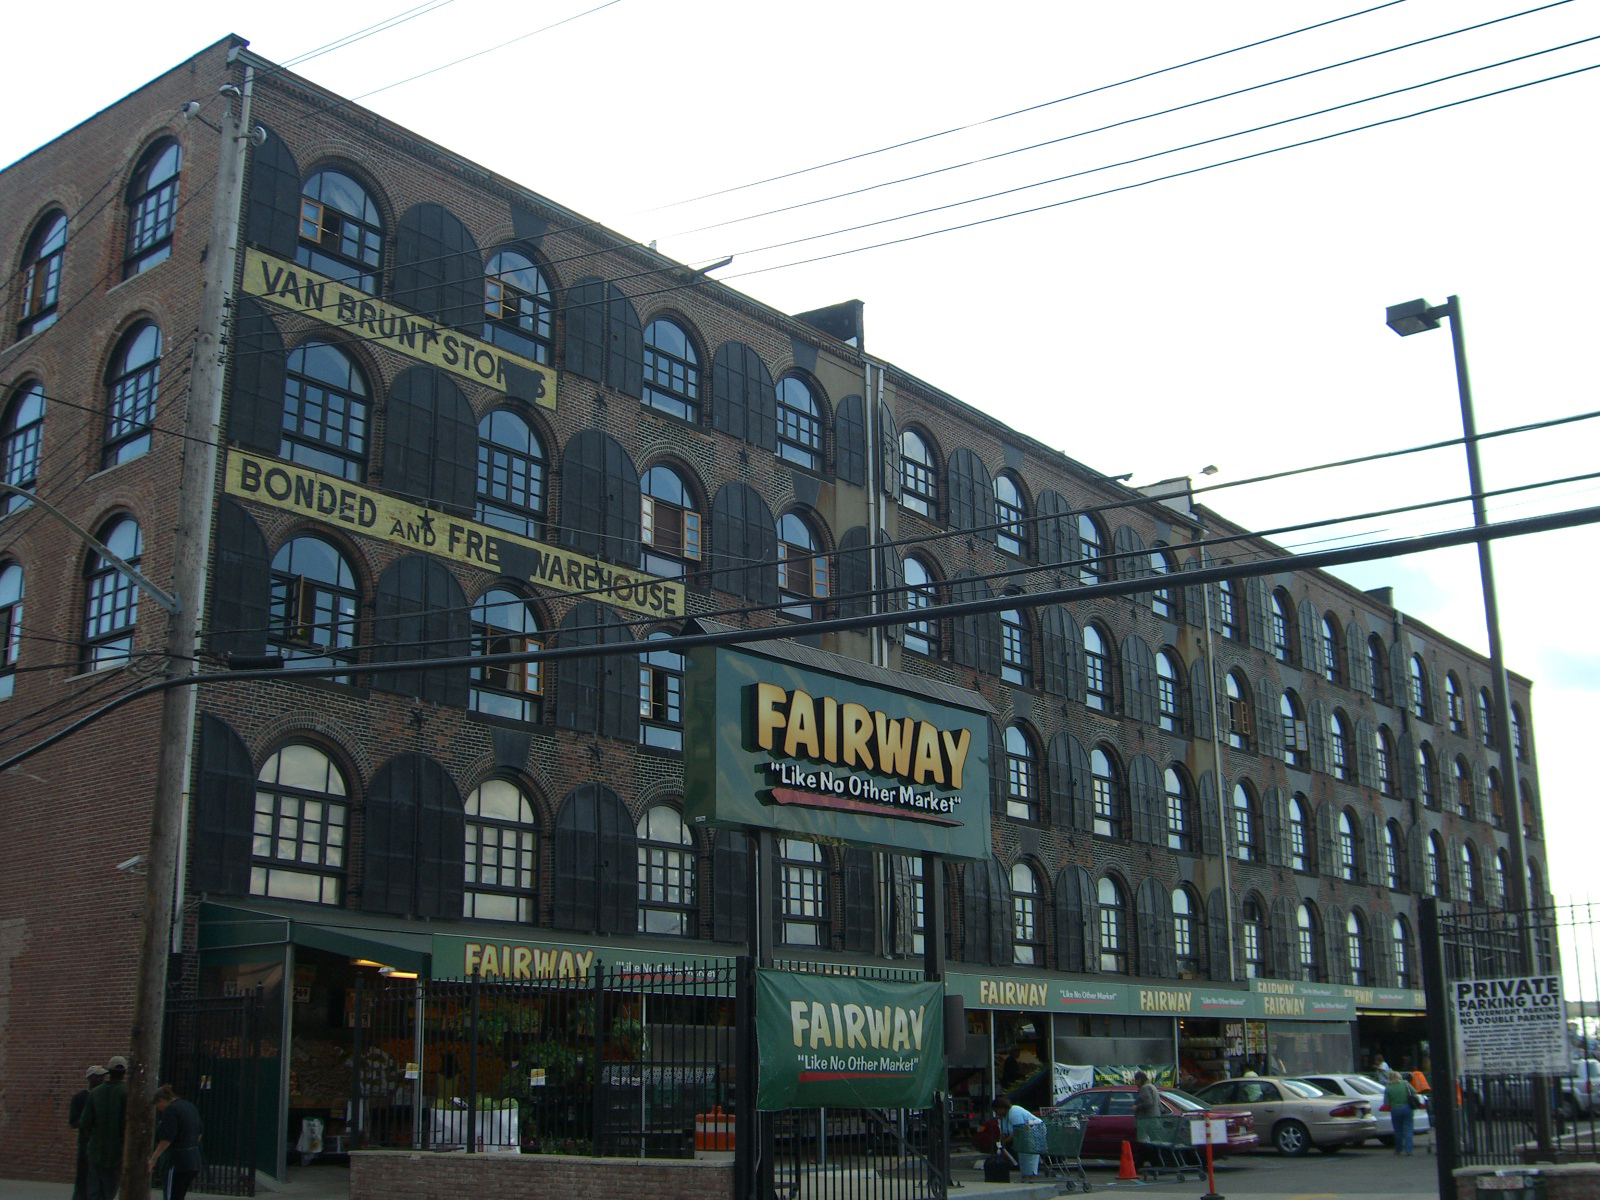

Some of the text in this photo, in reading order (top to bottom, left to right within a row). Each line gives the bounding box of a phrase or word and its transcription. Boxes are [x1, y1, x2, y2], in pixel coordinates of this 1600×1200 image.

[262, 261, 546, 399] VAN BRUNT STORS
[240, 458, 378, 528] BONDED
[389, 519, 436, 547] AND
[448, 523, 500, 566] FRE
[757, 682, 971, 790] FAIRWAY
[820, 771, 845, 793] No
[849, 775, 896, 803] Other
[464, 942, 594, 983] FAIRWAY
[980, 980, 1048, 1007] FAIRWAY
[1457, 977, 1559, 999] PRIVATE
[1139, 990, 1192, 1013] FAIRWAY
[1264, 996, 1305, 1016] FAIRWAY
[1458, 995, 1560, 1011] PARKING LOT
[1474, 1009, 1521, 1017] OVERNIGHT
[1523, 1006, 1560, 1014] PARKING
[790, 1000, 925, 1052] FAIRWAY
[1477, 1015, 1514, 1025] DOUBLE
[1517, 1013, 1561, 1023] PARKING
[830, 1056, 846, 1071] No
[848, 1056, 878, 1071] Other
